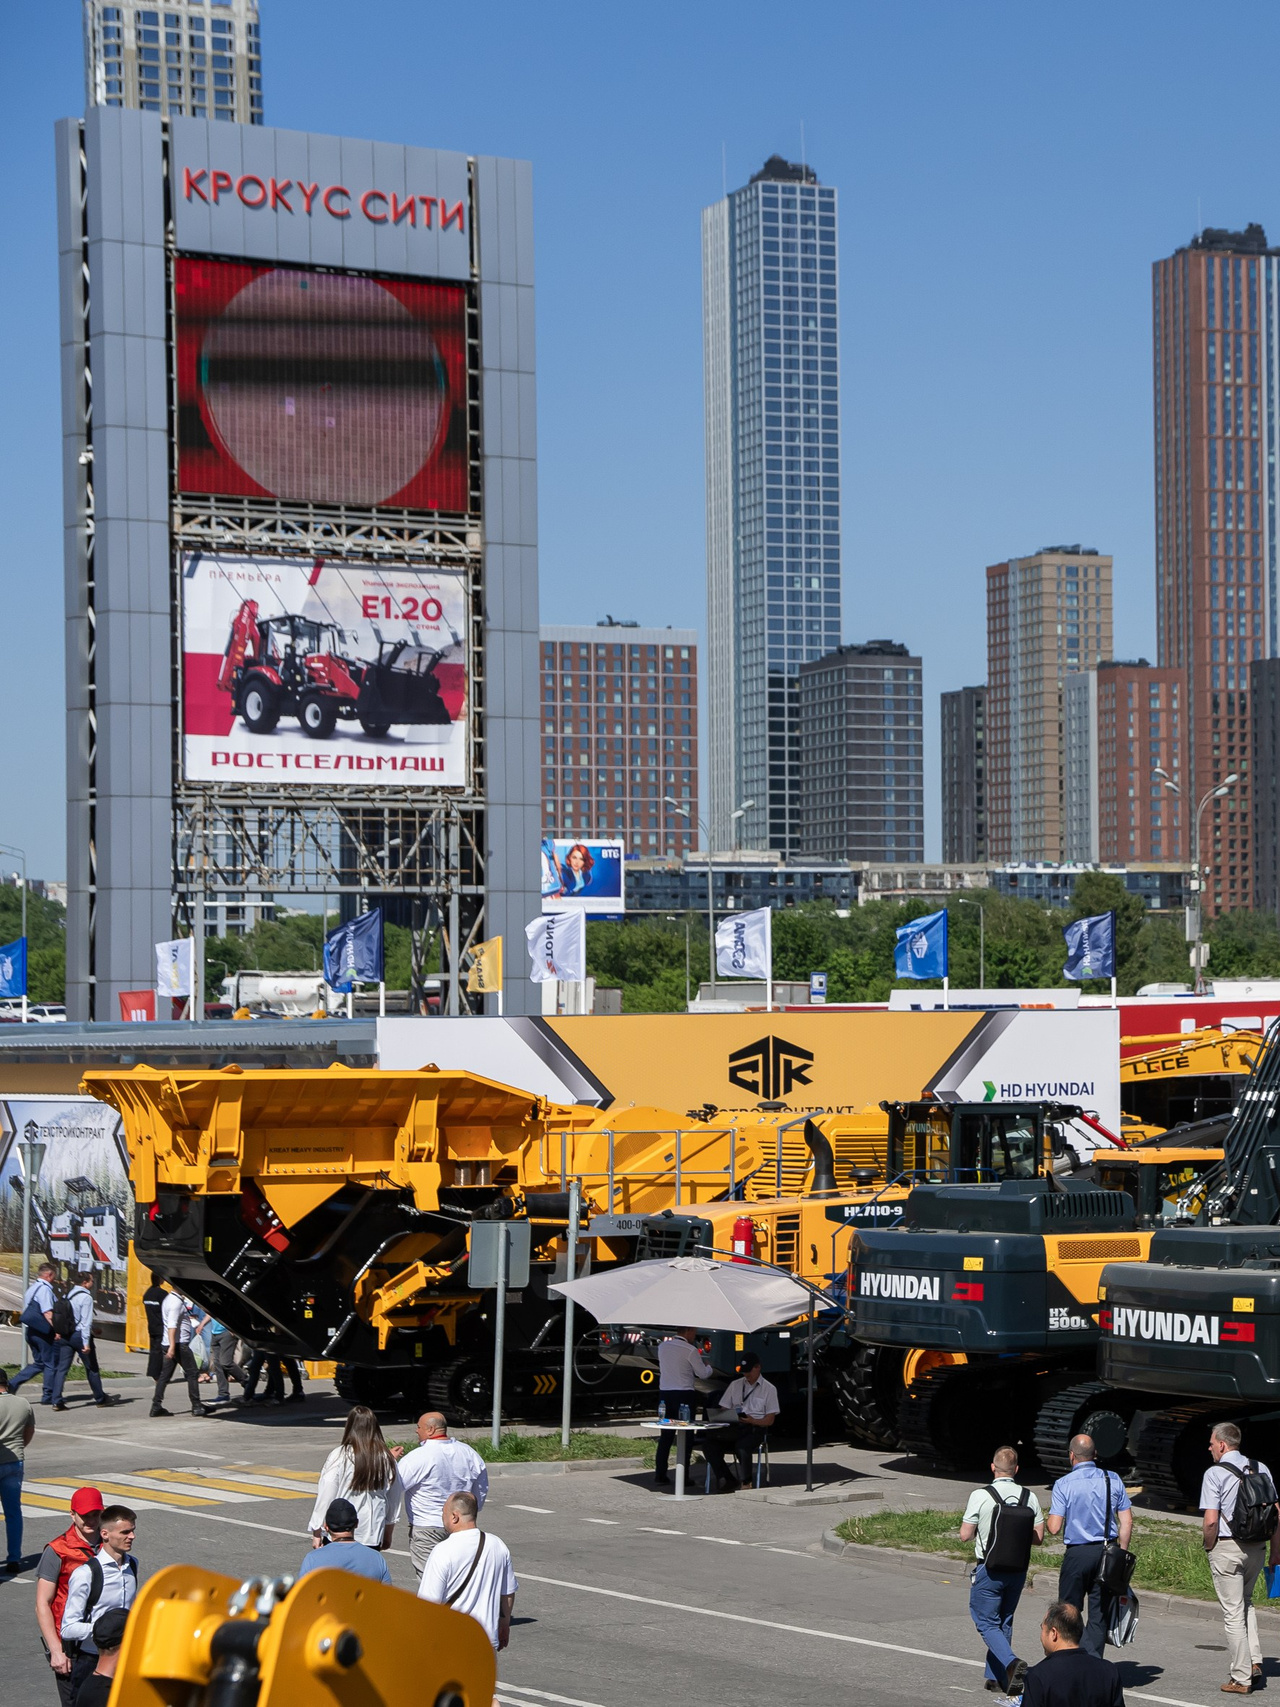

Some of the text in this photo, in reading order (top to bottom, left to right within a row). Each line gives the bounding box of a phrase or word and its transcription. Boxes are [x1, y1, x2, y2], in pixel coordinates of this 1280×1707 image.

[183, 167, 465, 232] КРОКУС СИТИ
[209, 570, 282, 583] ПРЕМЬЕРА
[362, 595, 443, 622] E1.20
[416, 624, 440, 632] стенд
[211, 751, 445, 772] РОСТСЕЛЬМАШ
[601, 849, 620, 859] ВТБ
[1000, 1082, 1095, 1097] HD HYUNDAI
[40, 1126, 105, 1139] ТЕХСТРОЙКОНТРАКТ
[860, 1272, 940, 1301] HYUNDAI
[1049, 1307, 1069, 1318] HX
[1049, 1317, 1088, 1331] 500L
[1113, 1307, 1219, 1345] HYUNDAI
